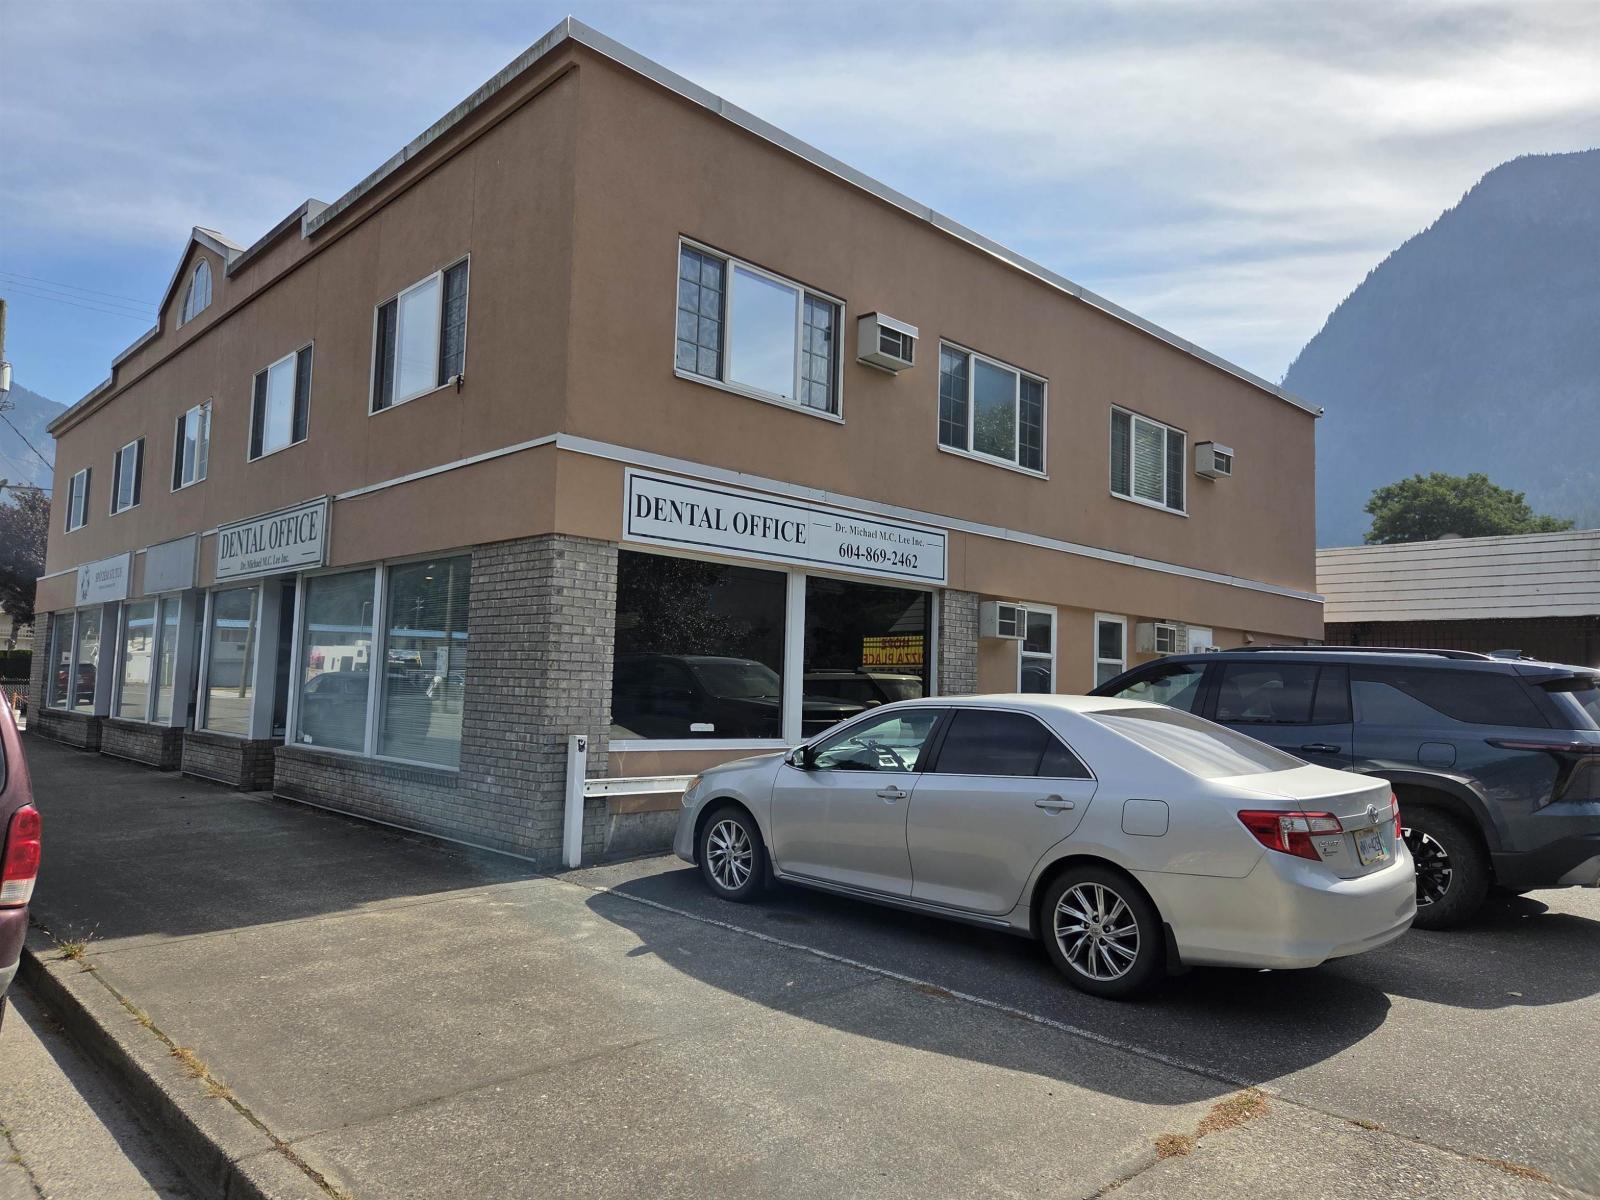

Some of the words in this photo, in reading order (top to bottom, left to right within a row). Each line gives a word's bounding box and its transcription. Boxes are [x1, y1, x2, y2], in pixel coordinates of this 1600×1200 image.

[221, 525, 265, 559] DENTAL
[269, 511, 318, 549] OFFICE
[636, 494, 727, 531] DENTAL
[733, 512, 806, 544] OFFICE
[835, 523, 847, 533] Dr.
[850, 525, 878, 539] Michael
[879, 531, 897, 543] M.C.
[898, 534, 910, 545] Lee
[912, 537, 924, 547] Inc.
[839, 543, 918, 568] 604-869-2462
